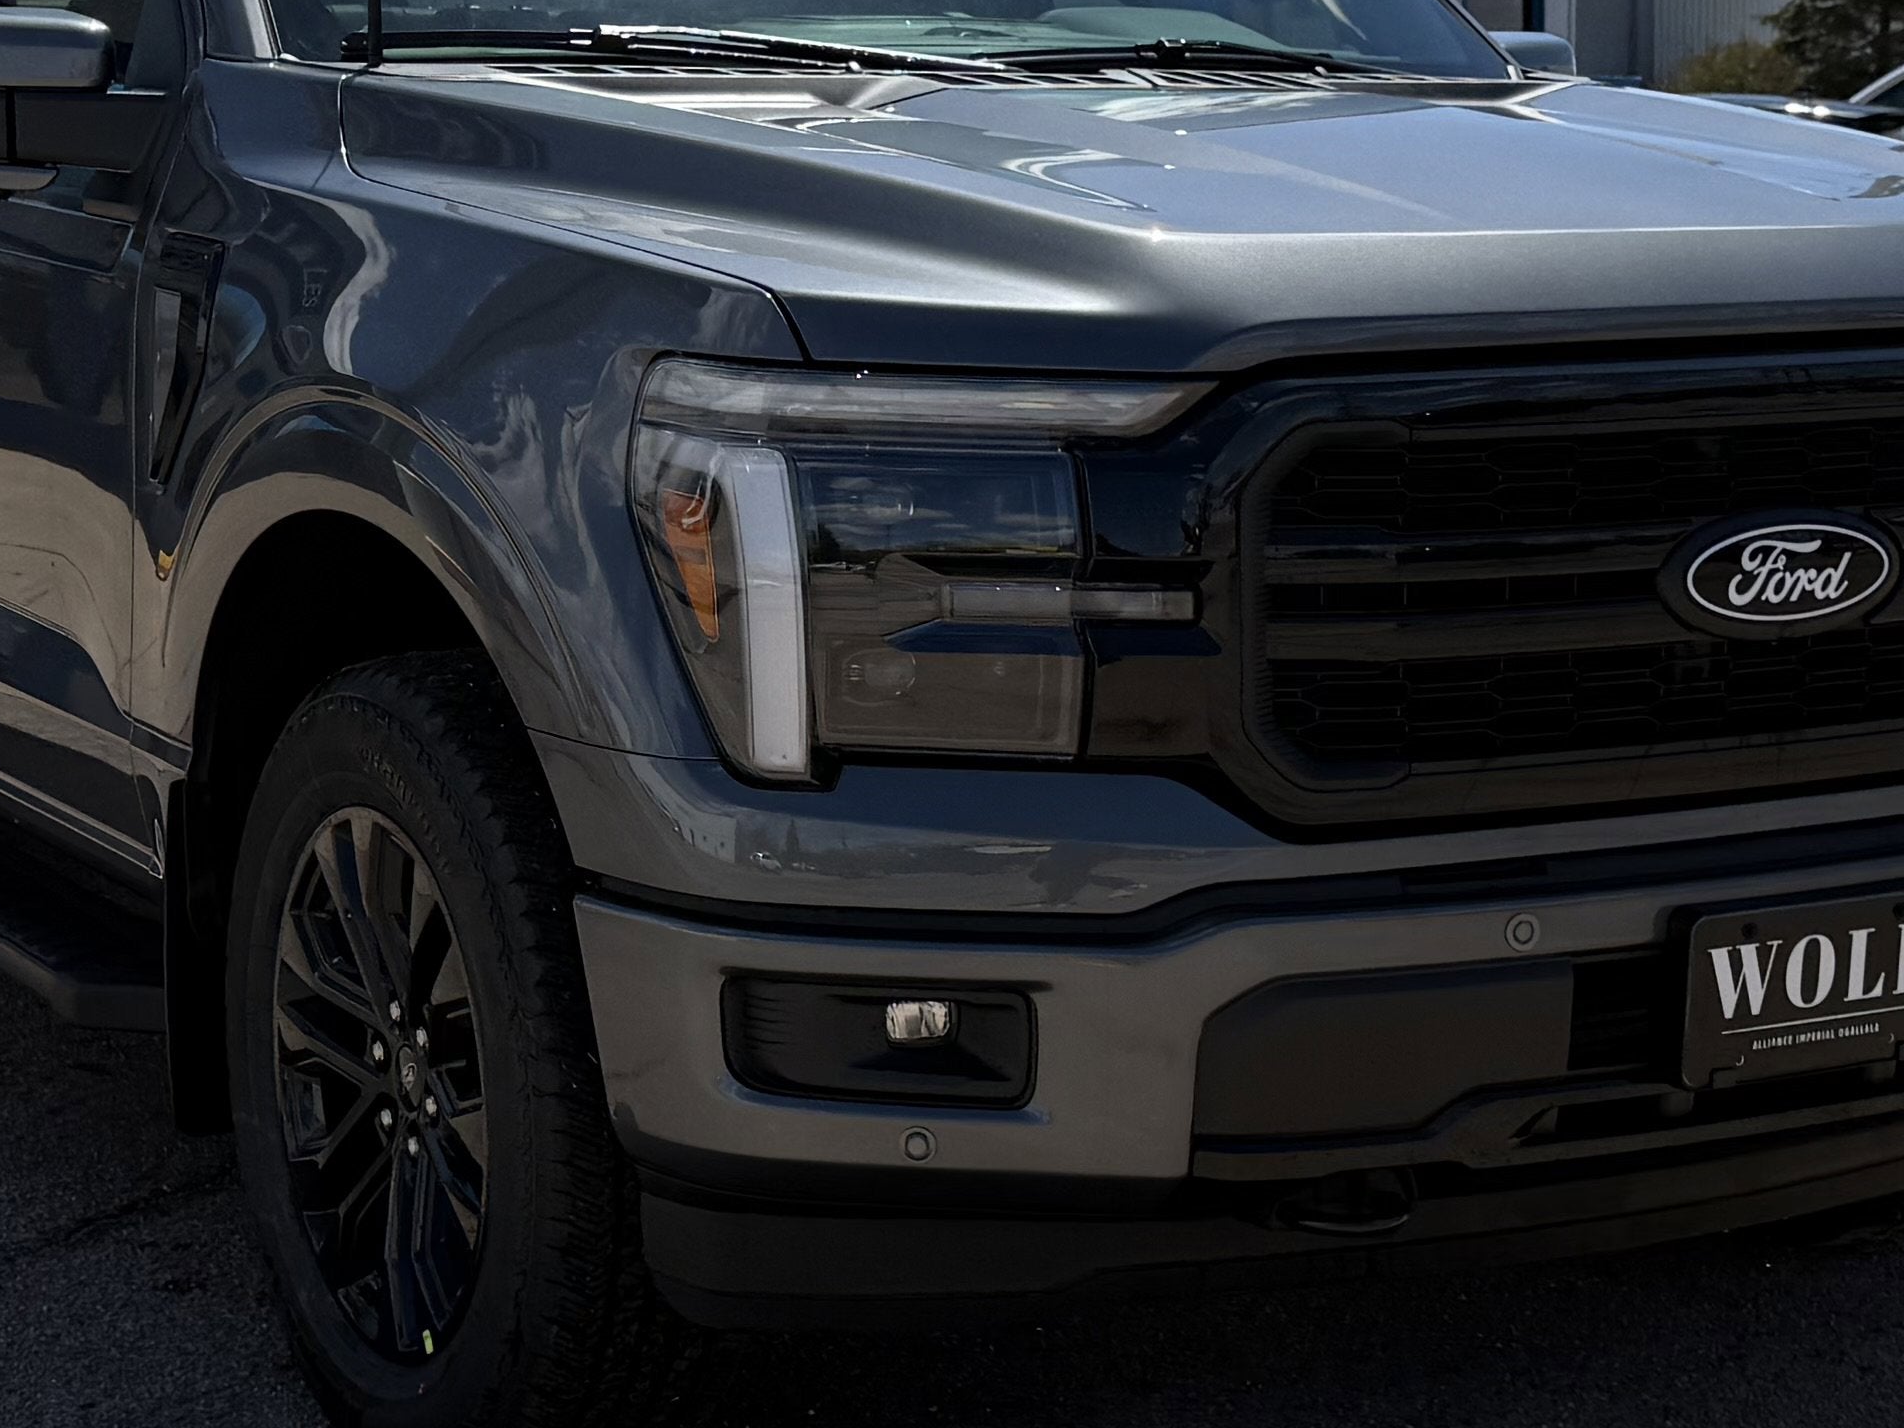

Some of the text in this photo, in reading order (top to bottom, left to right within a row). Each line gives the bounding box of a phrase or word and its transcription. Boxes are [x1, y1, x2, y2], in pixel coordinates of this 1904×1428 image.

[1728, 539, 1853, 606] Ford
[1752, 1022, 1880, 1050] ALLIANCE IMPERIAL OGALLALA
